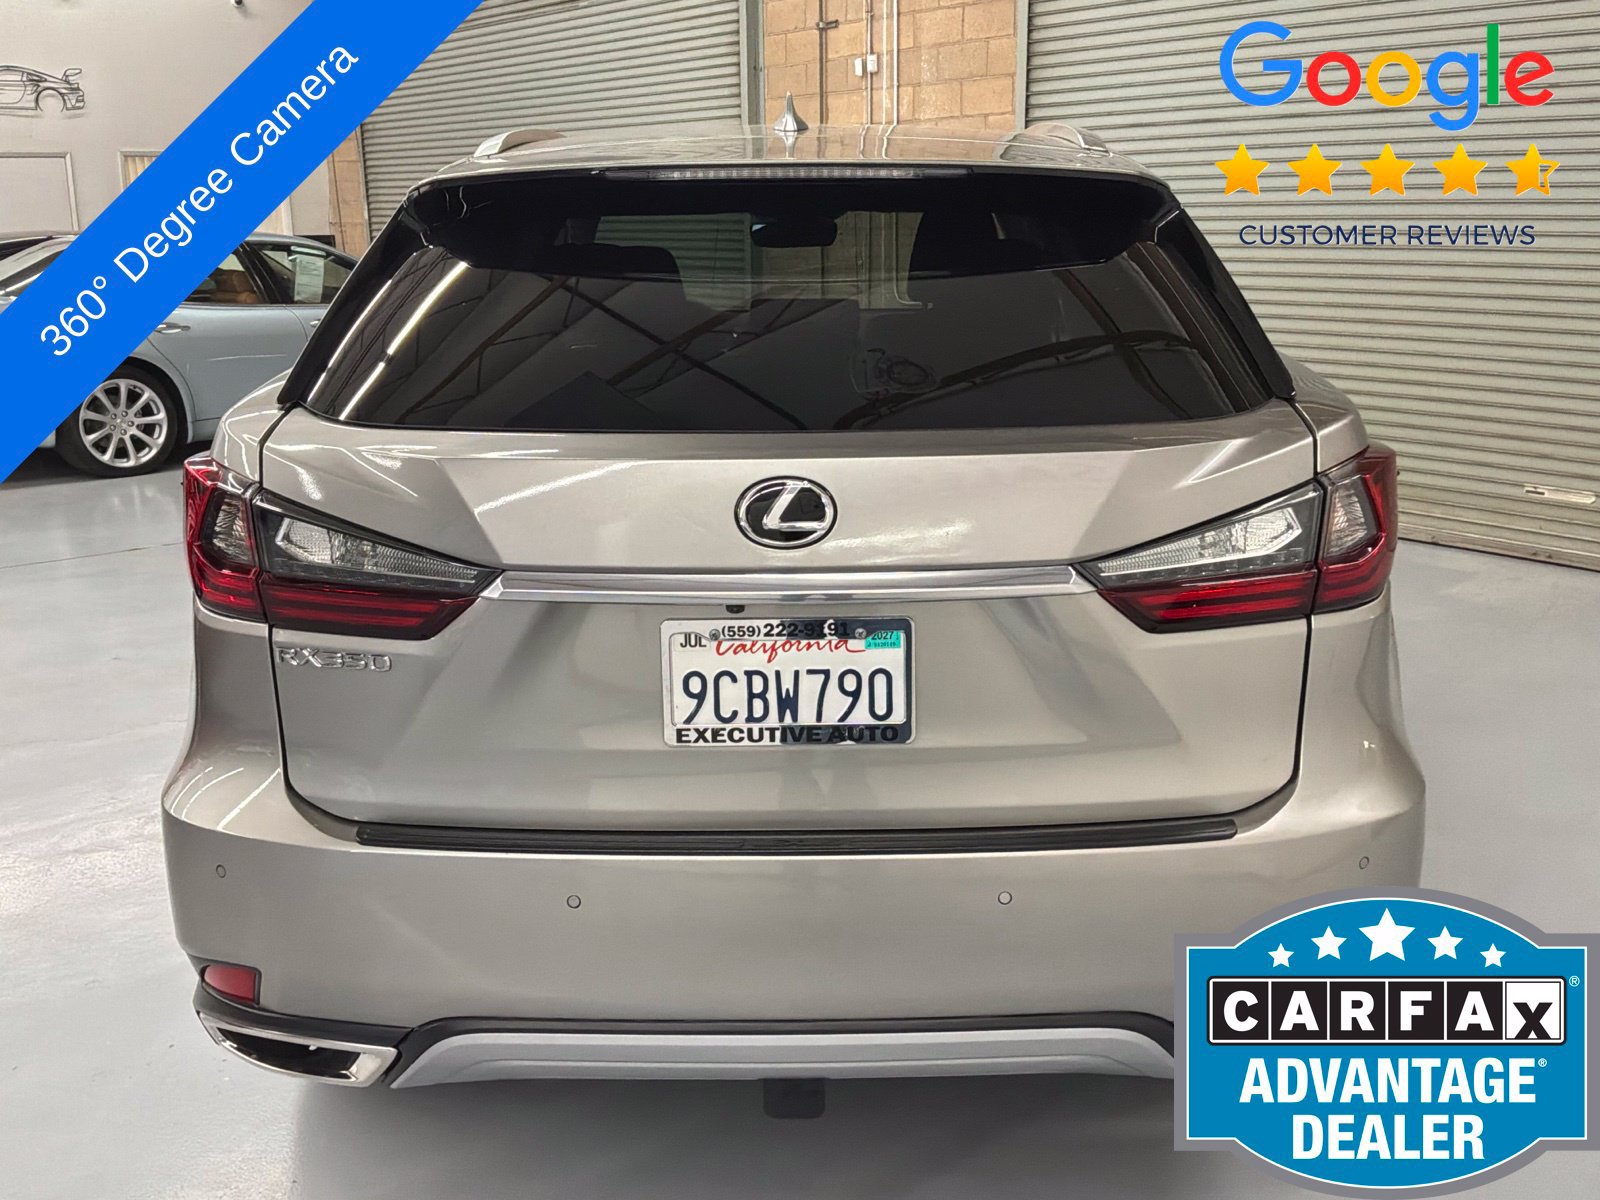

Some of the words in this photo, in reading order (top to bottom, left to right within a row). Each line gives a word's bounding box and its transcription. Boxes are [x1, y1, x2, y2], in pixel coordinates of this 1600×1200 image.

[721, 625, 761, 638] (559)
[763, 621, 849, 638] 222-9191
[871, 631, 894, 640] 2027
[680, 633, 705, 648] JUL
[716, 640, 866, 663] California
[682, 668, 894, 724] 9CBW790
[675, 726, 821, 743] EXECUTIVE
[828, 725, 899, 742] AUTO
